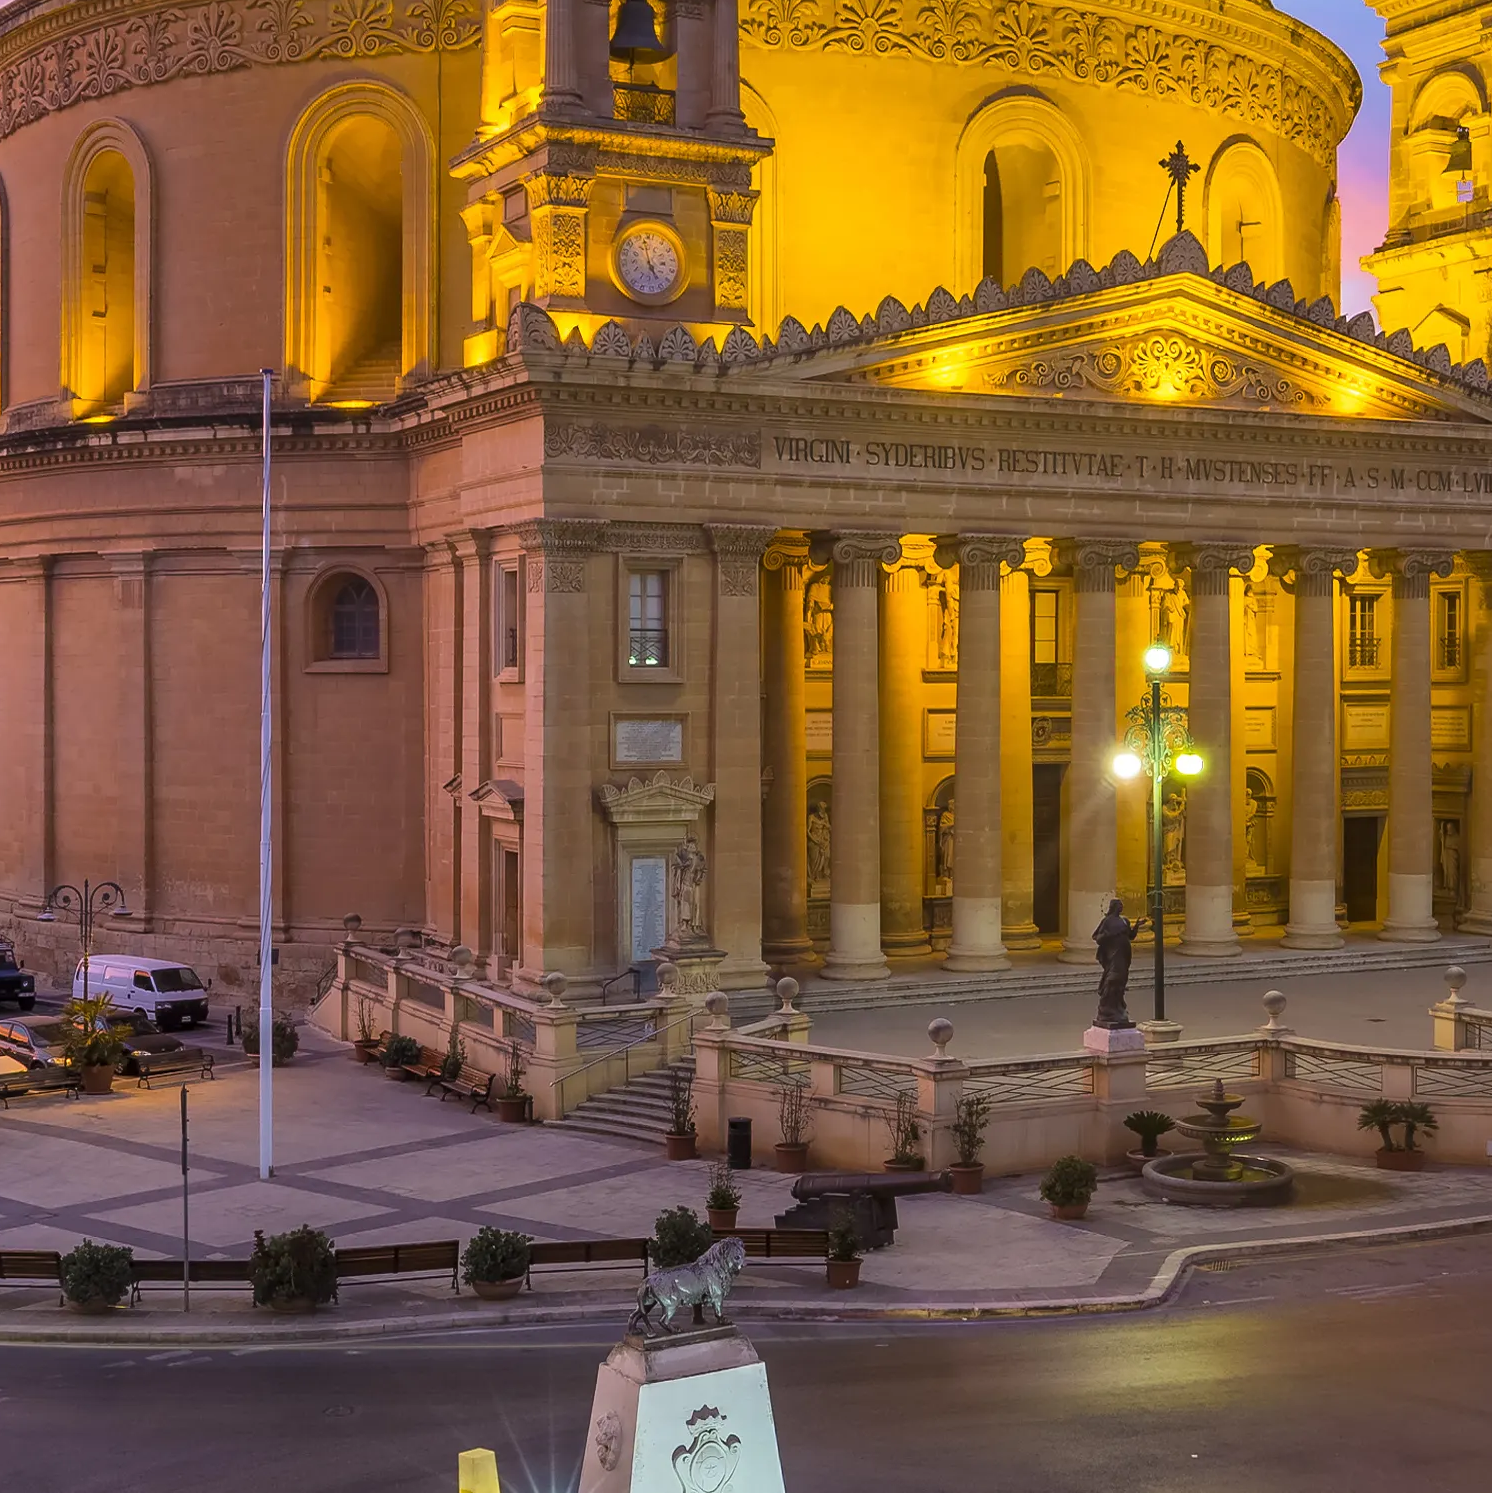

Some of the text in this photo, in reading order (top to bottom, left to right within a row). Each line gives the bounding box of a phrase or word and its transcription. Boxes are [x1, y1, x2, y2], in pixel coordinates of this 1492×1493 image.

[773, 436, 852, 465] VIRGINI
[865, 441, 986, 471] SYDERIBVS
[998, 448, 1123, 478] RESTITVTAE
[1135, 455, 1149, 478] T
[1160, 456, 1173, 480] H
[1185, 458, 1298, 486] MVSTENSES
[1309, 464, 1333, 487] FF
[1343, 466, 1357, 488] A
[1367, 467, 1380, 489] S
[1390, 468, 1405, 490] M
[1416, 469, 1452, 492] CCM
